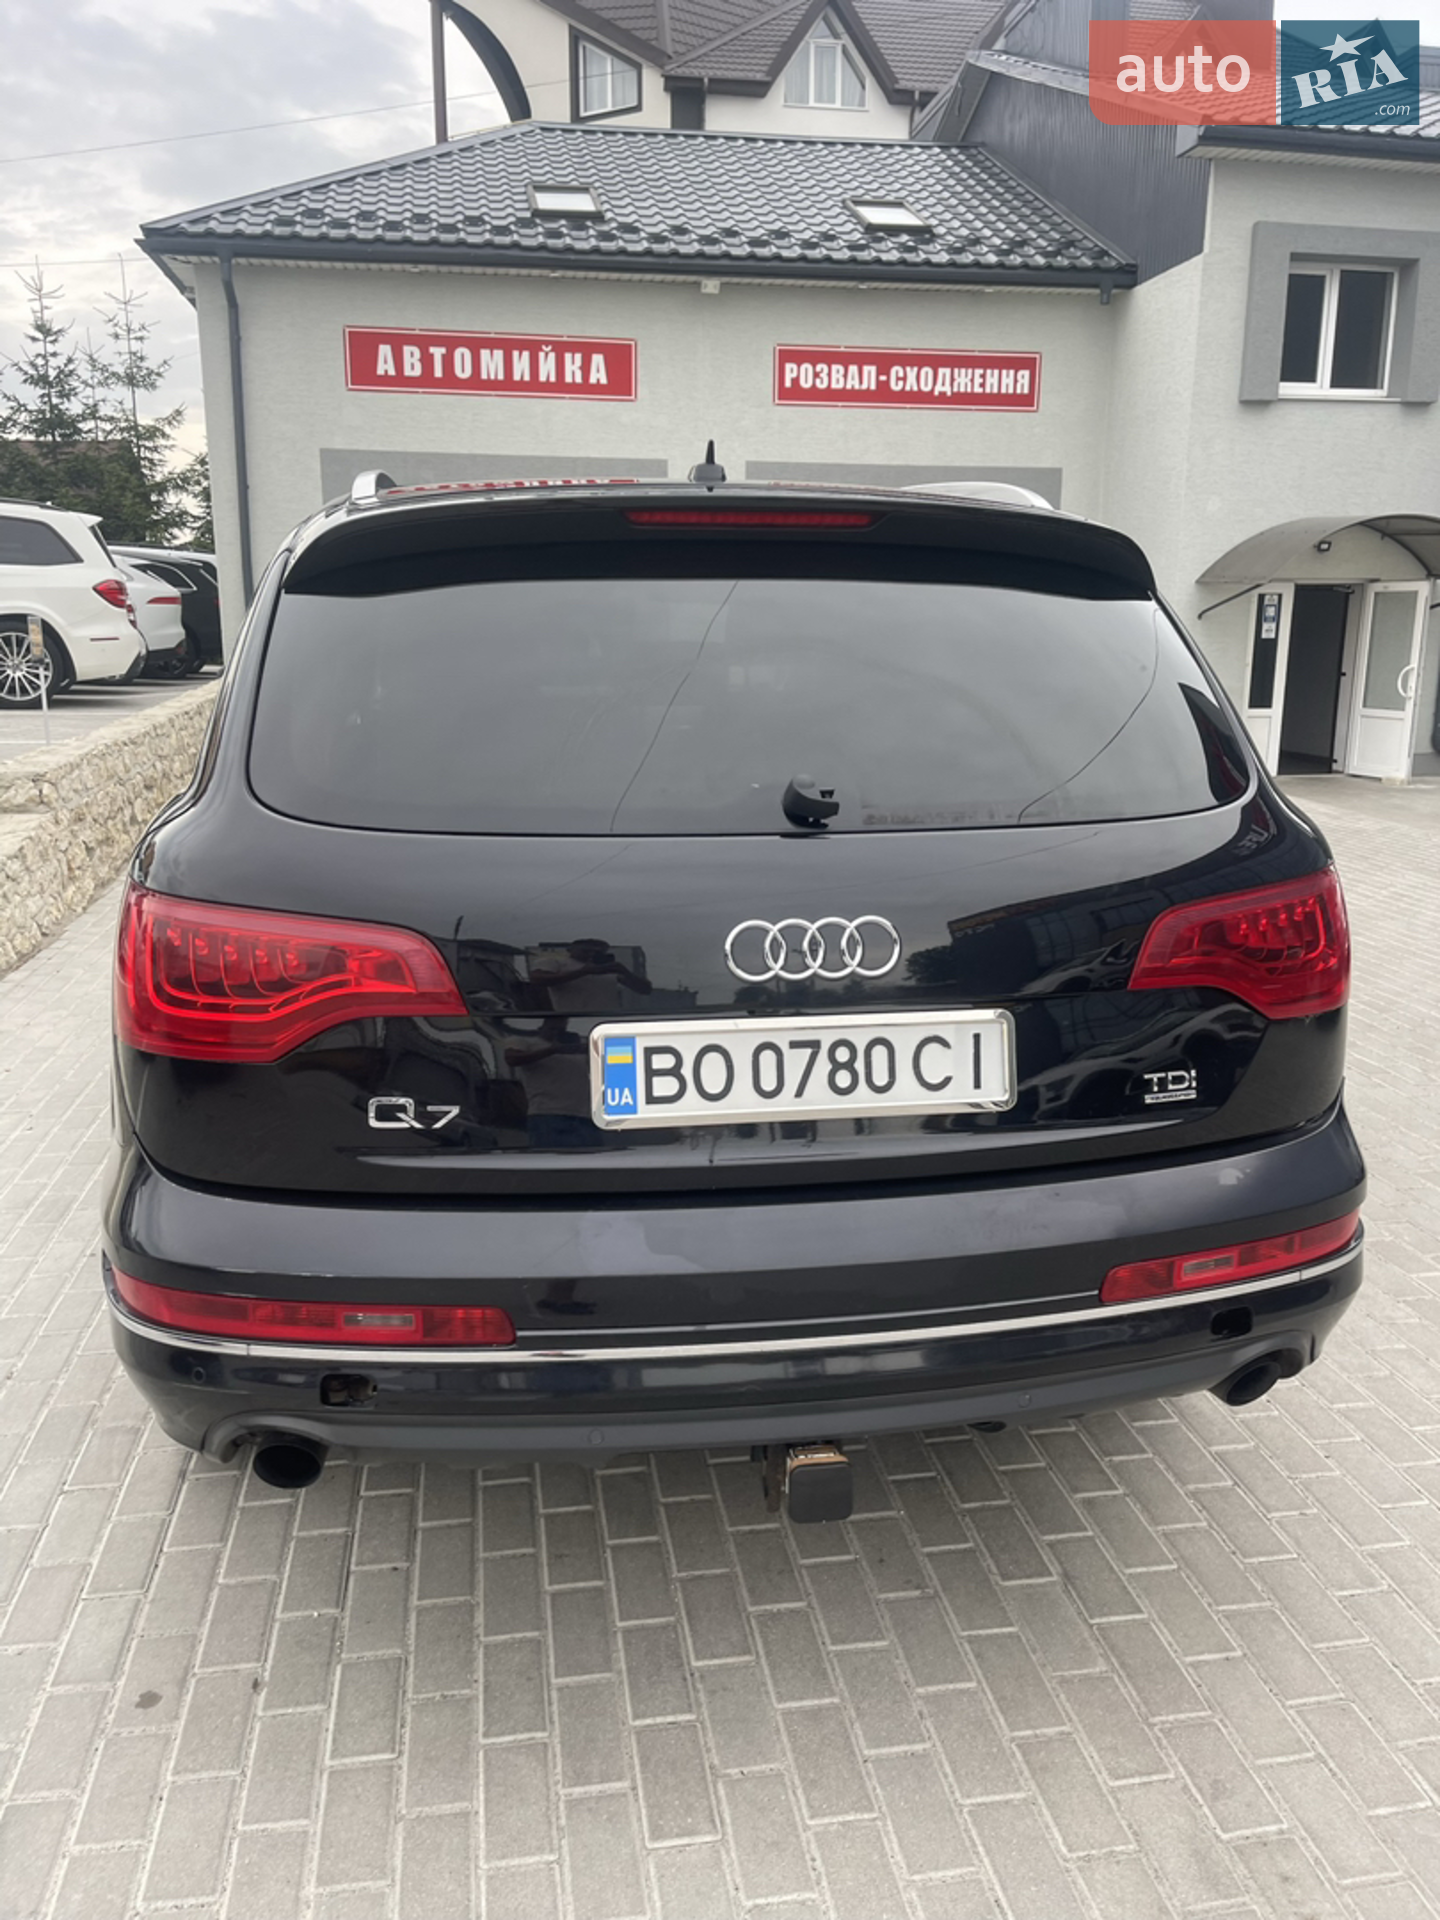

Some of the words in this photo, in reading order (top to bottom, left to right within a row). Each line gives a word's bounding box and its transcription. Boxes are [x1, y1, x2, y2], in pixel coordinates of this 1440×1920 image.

[376, 344, 608, 385] АВТОМИЙКА
[784, 362, 1031, 397] РОЗВАЛ-СХОДЖЕННЯ
[643, 1043, 735, 1105] BO
[751, 1036, 897, 1100] 0780
[1143, 1069, 1197, 1092] TDI
[367, 1096, 460, 1129] Q7
[607, 1087, 634, 1107] UA
